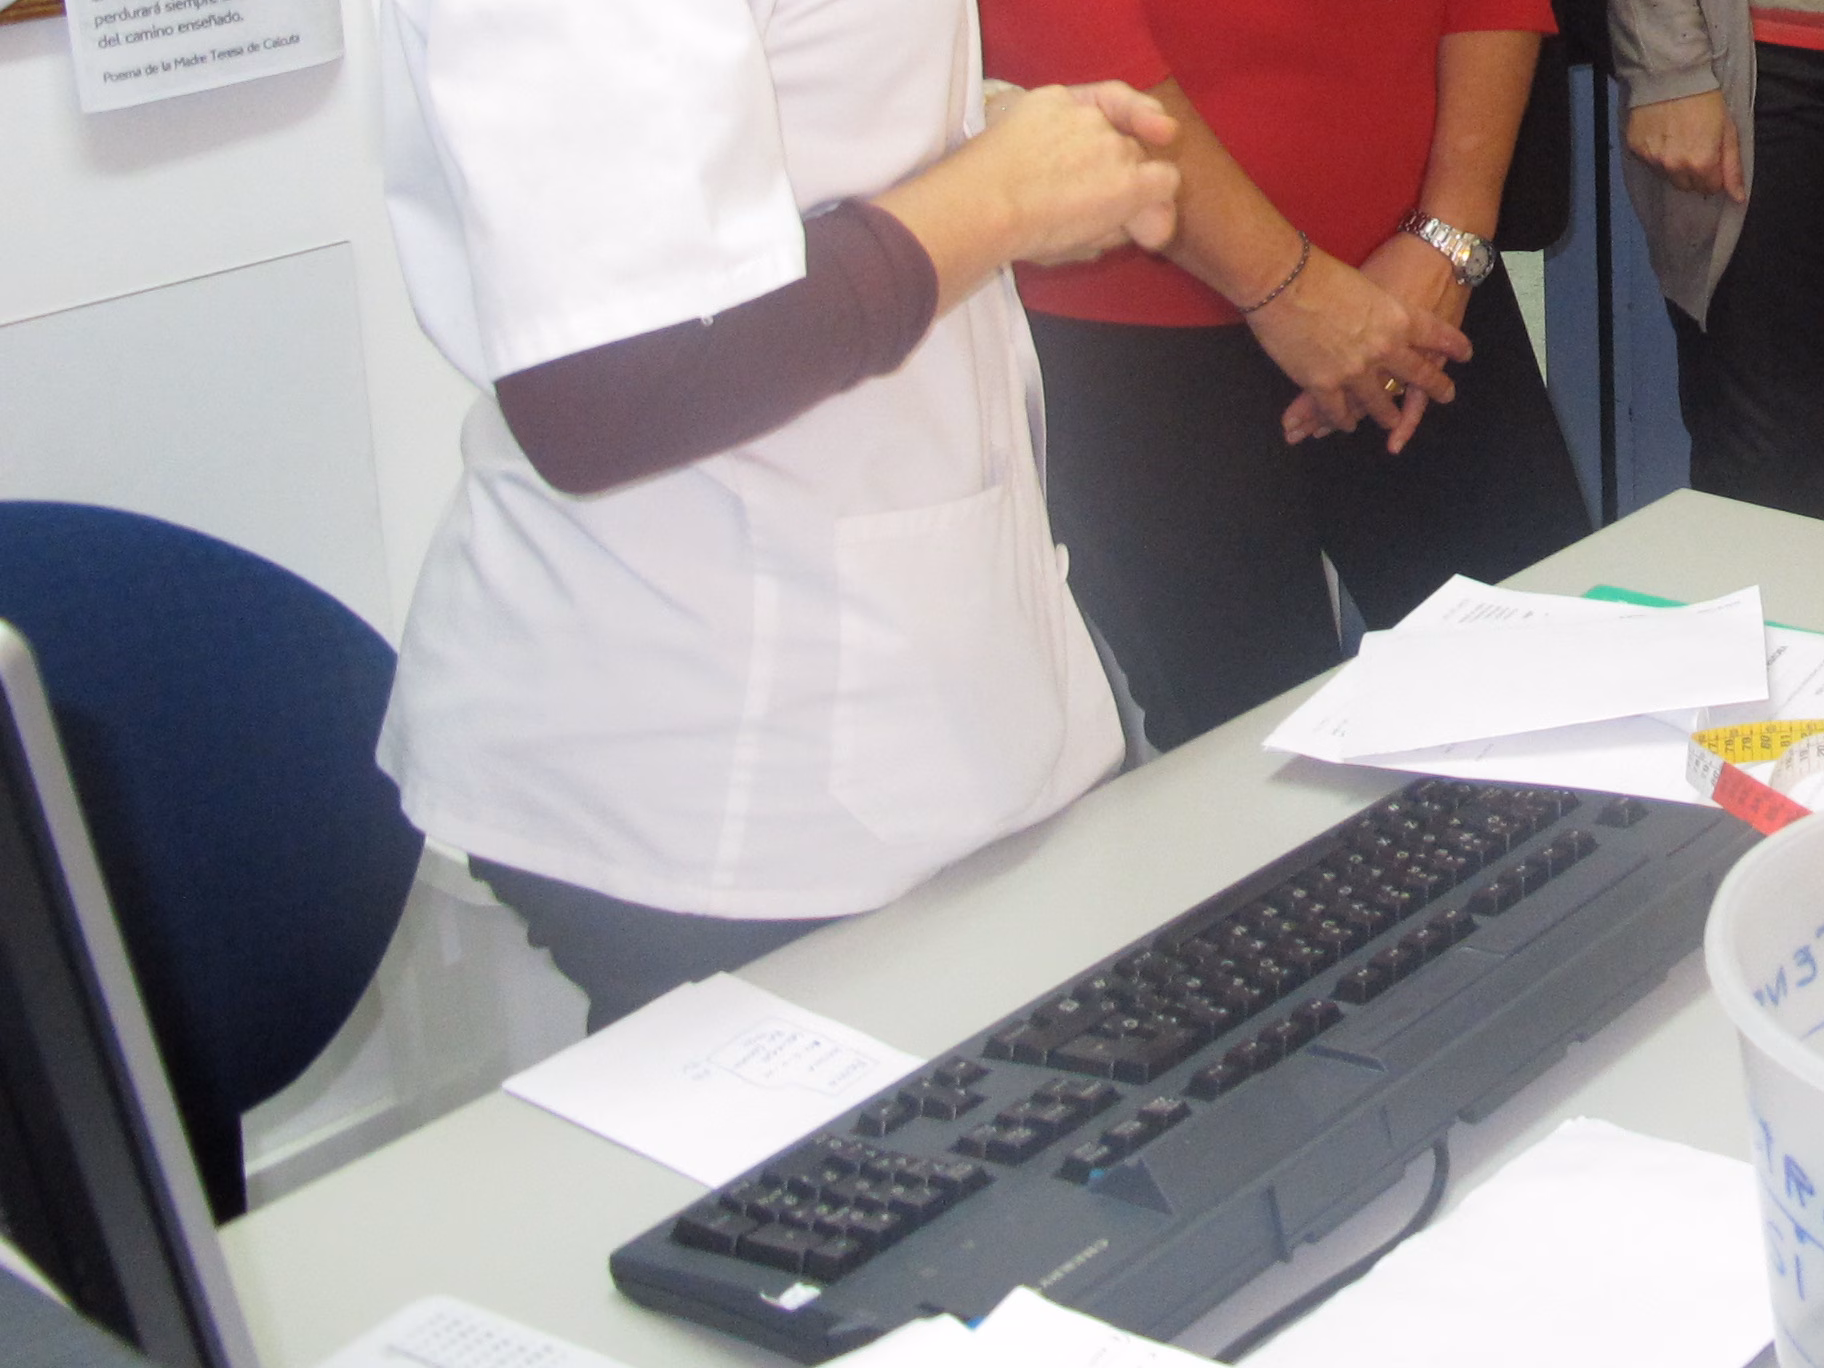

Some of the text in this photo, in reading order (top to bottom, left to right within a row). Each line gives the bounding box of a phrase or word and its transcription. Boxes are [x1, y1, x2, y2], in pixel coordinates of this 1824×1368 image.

[94, 1, 161, 29] perdurará
[98, 10, 244, 49] del camino enseñado.
[103, 67, 142, 84] Poema
[145, 64, 159, 76] de
[161, 61, 171, 72] la
[174, 53, 208, 70] Madre
[210, 46, 244, 62] Teresa
[247, 42, 261, 53] de
